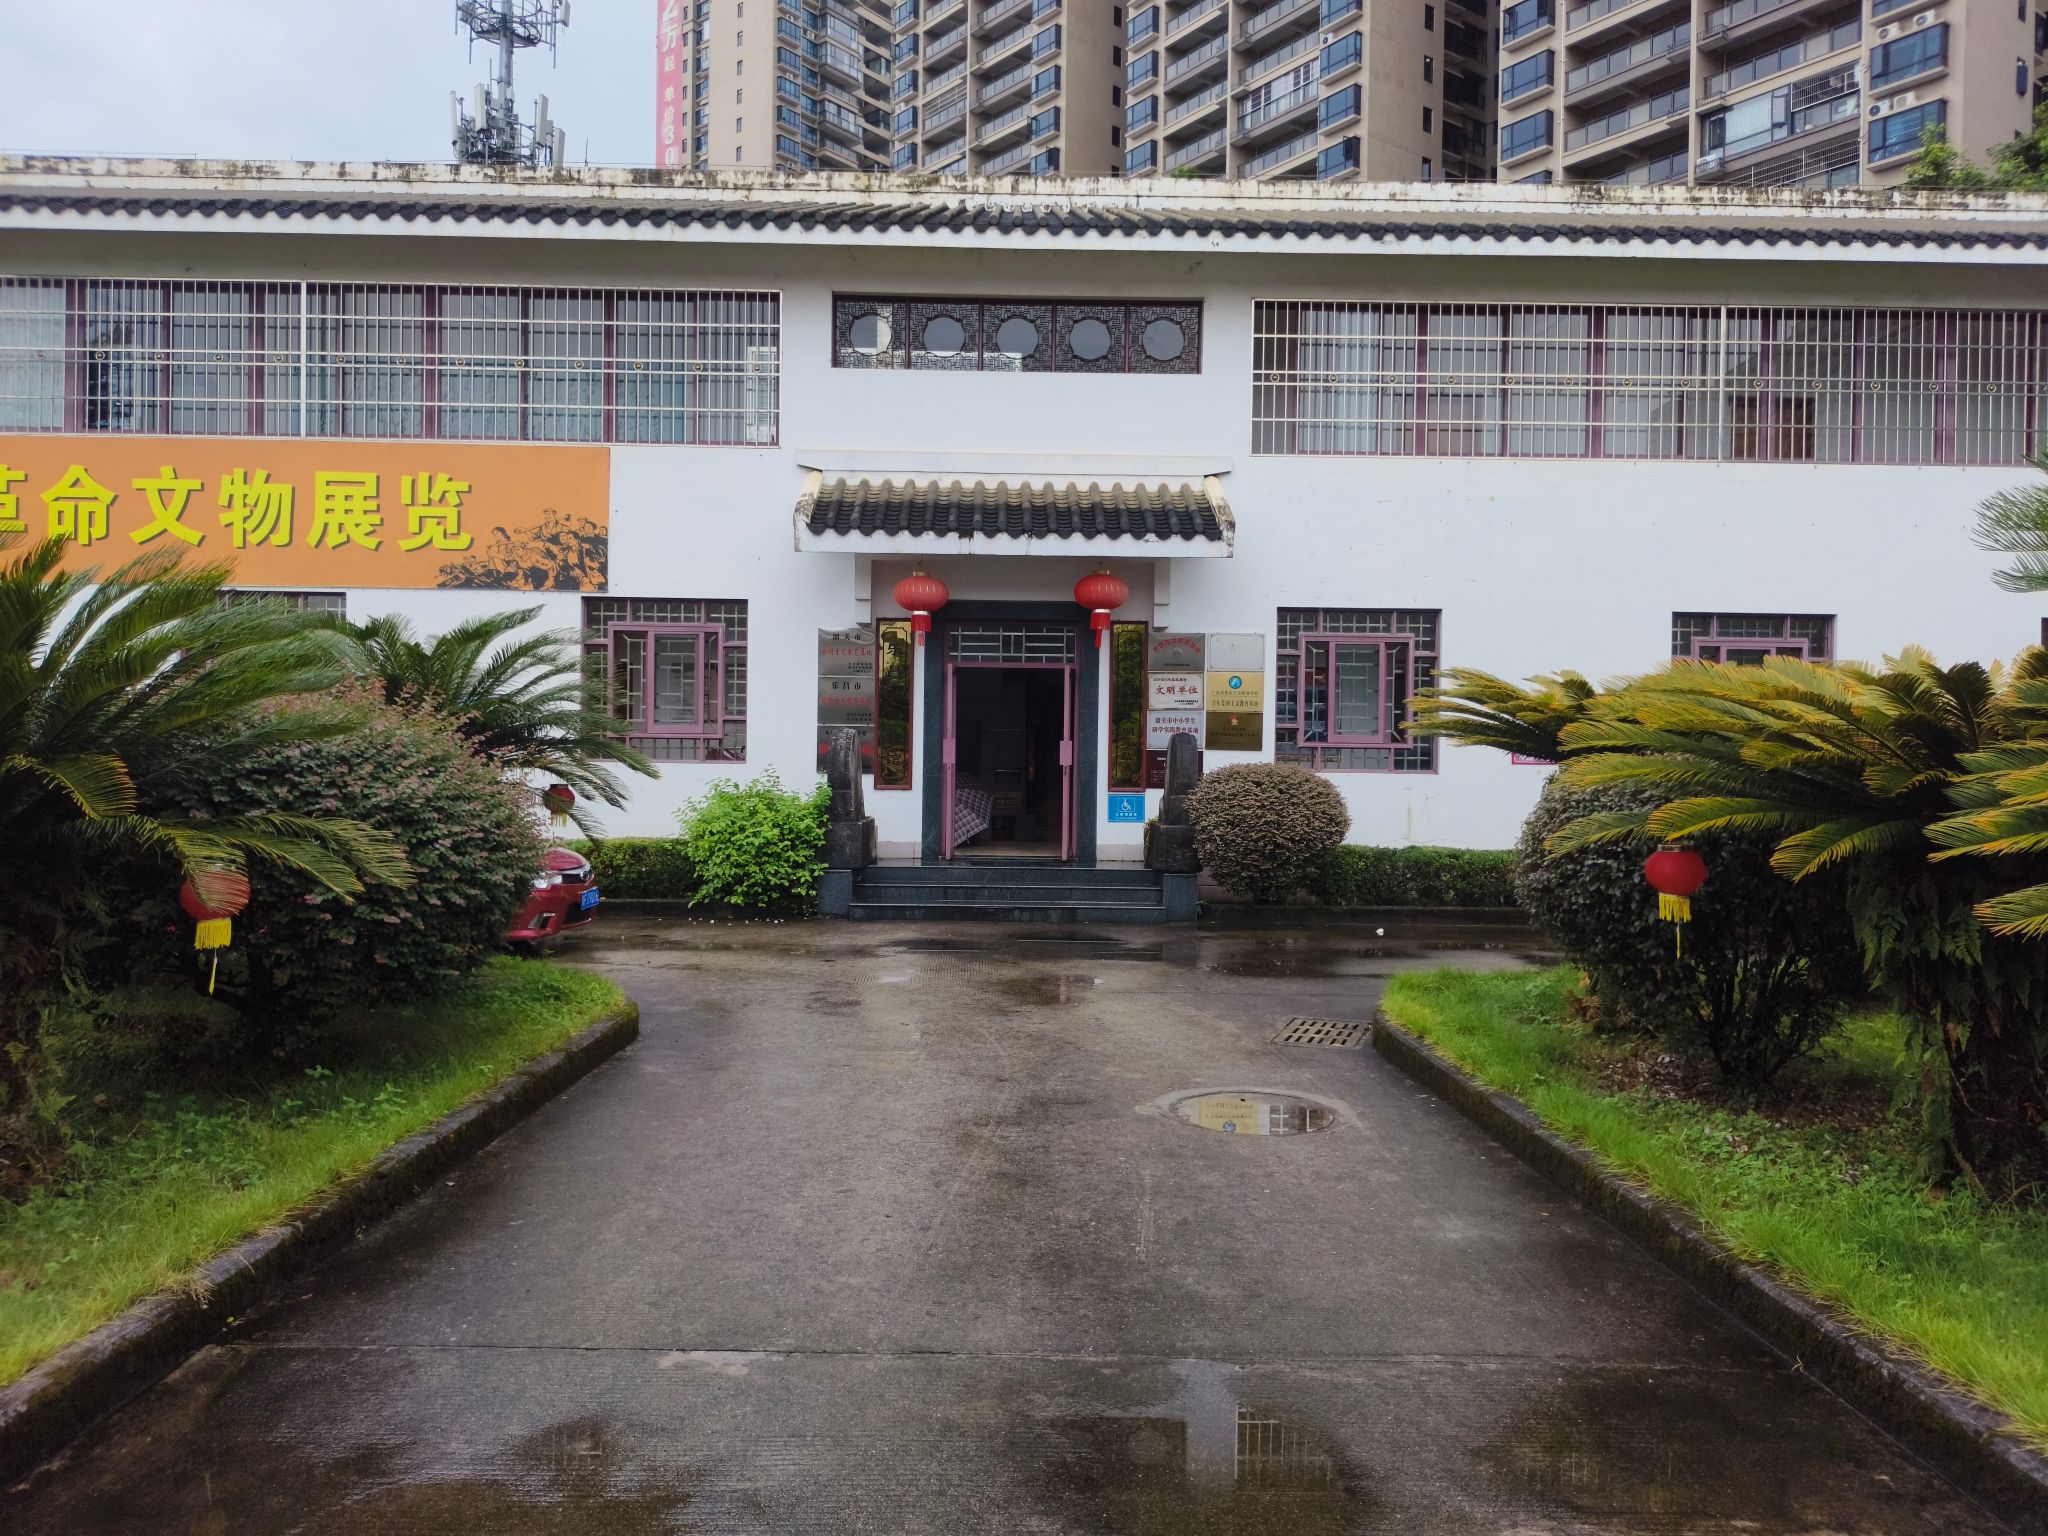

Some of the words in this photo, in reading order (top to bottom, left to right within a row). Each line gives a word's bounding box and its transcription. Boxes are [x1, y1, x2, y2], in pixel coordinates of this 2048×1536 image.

[832, 682, 862, 691] 乐昌市
[1155, 685, 1199, 695] 文明单位
[1155, 717, 1196, 725] 韶关市中小学生
